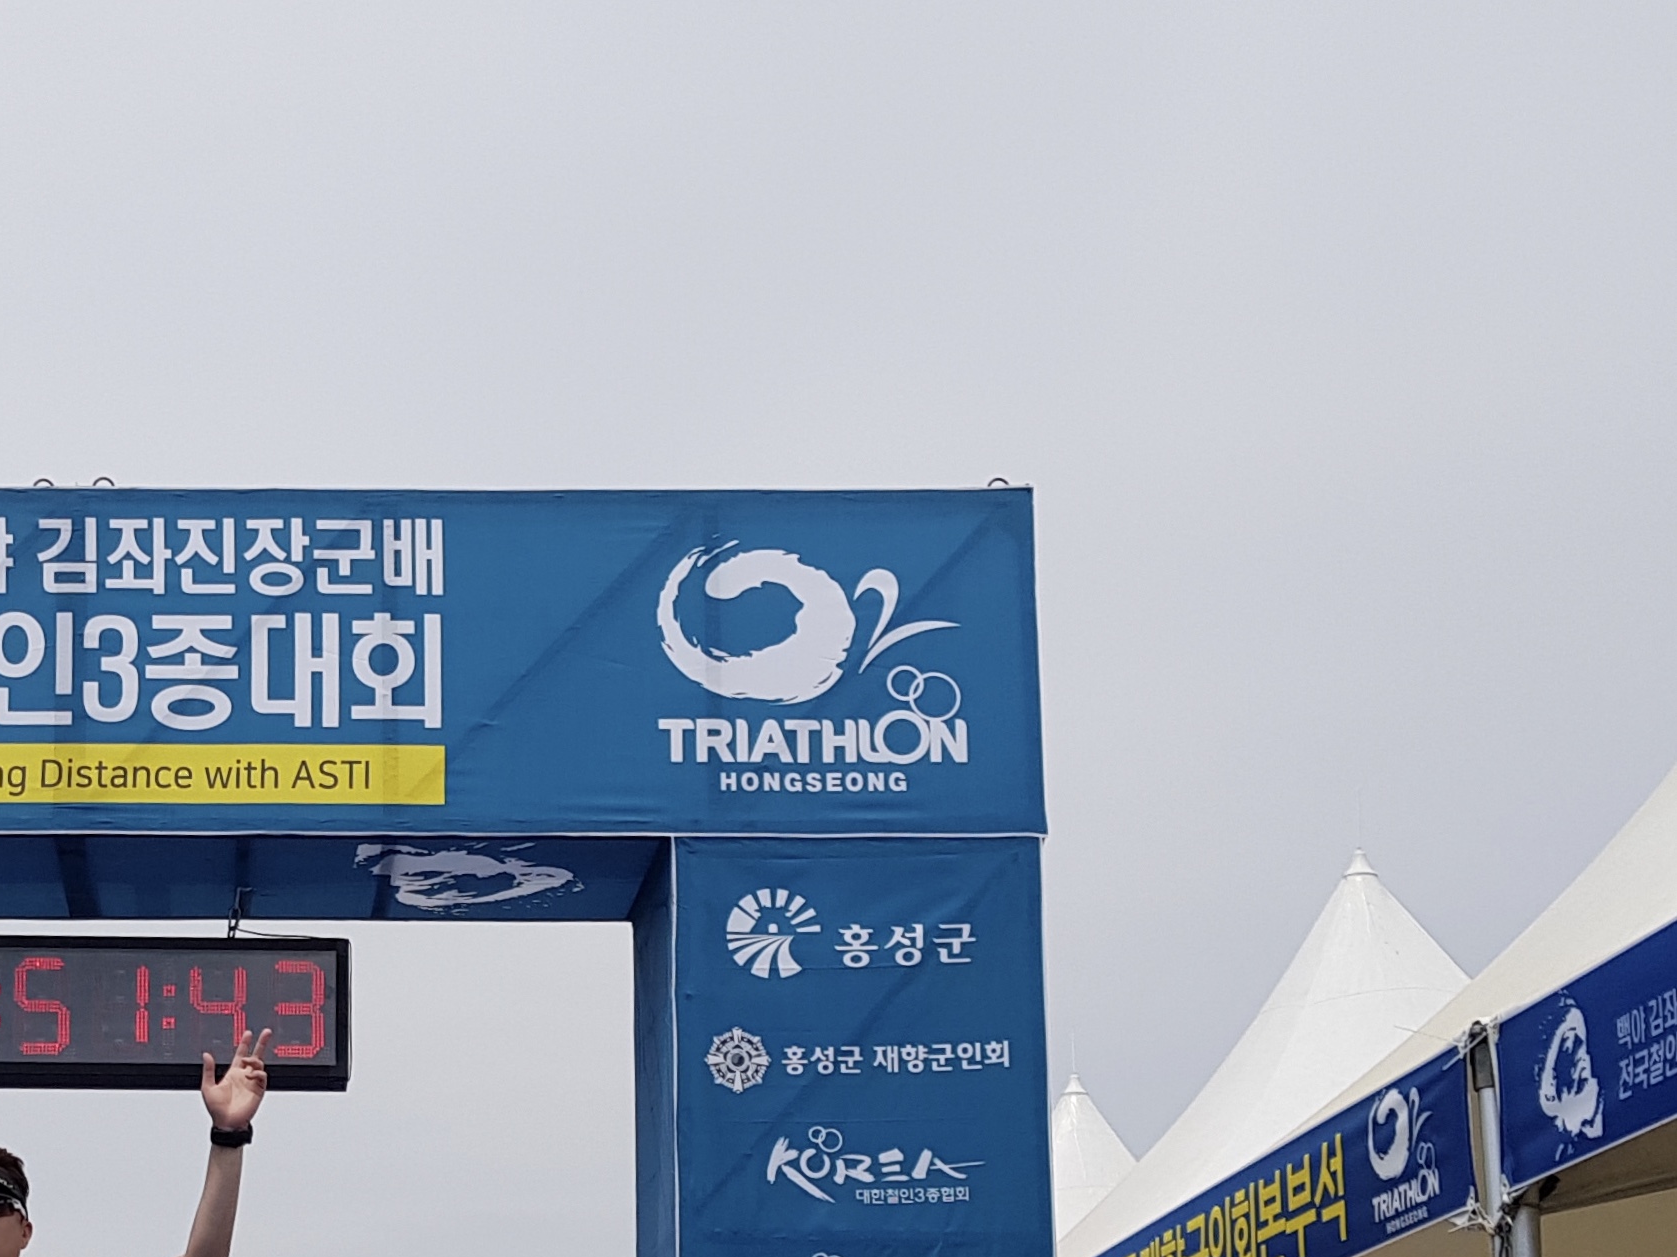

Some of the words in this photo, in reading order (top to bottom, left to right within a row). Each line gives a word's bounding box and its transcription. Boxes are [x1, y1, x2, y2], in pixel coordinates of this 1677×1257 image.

[36, 516, 445, 597] 김좌진장군배
[657, 710, 968, 763] TRIATHLON
[39, 756, 194, 791] Distance
[203, 756, 281, 791] with
[290, 757, 373, 791] ASTI
[719, 770, 909, 793] HONGSEONG
[834, 922, 977, 969] 홍성군
[1616, 1005, 1646, 1050] 백야
[781, 1045, 864, 1076] 홍성군
[873, 1040, 1011, 1073] 재향군인회
[855, 1186, 971, 1205] 대한철인3종협회
[1371, 1168, 1441, 1224] TRIATHLON
